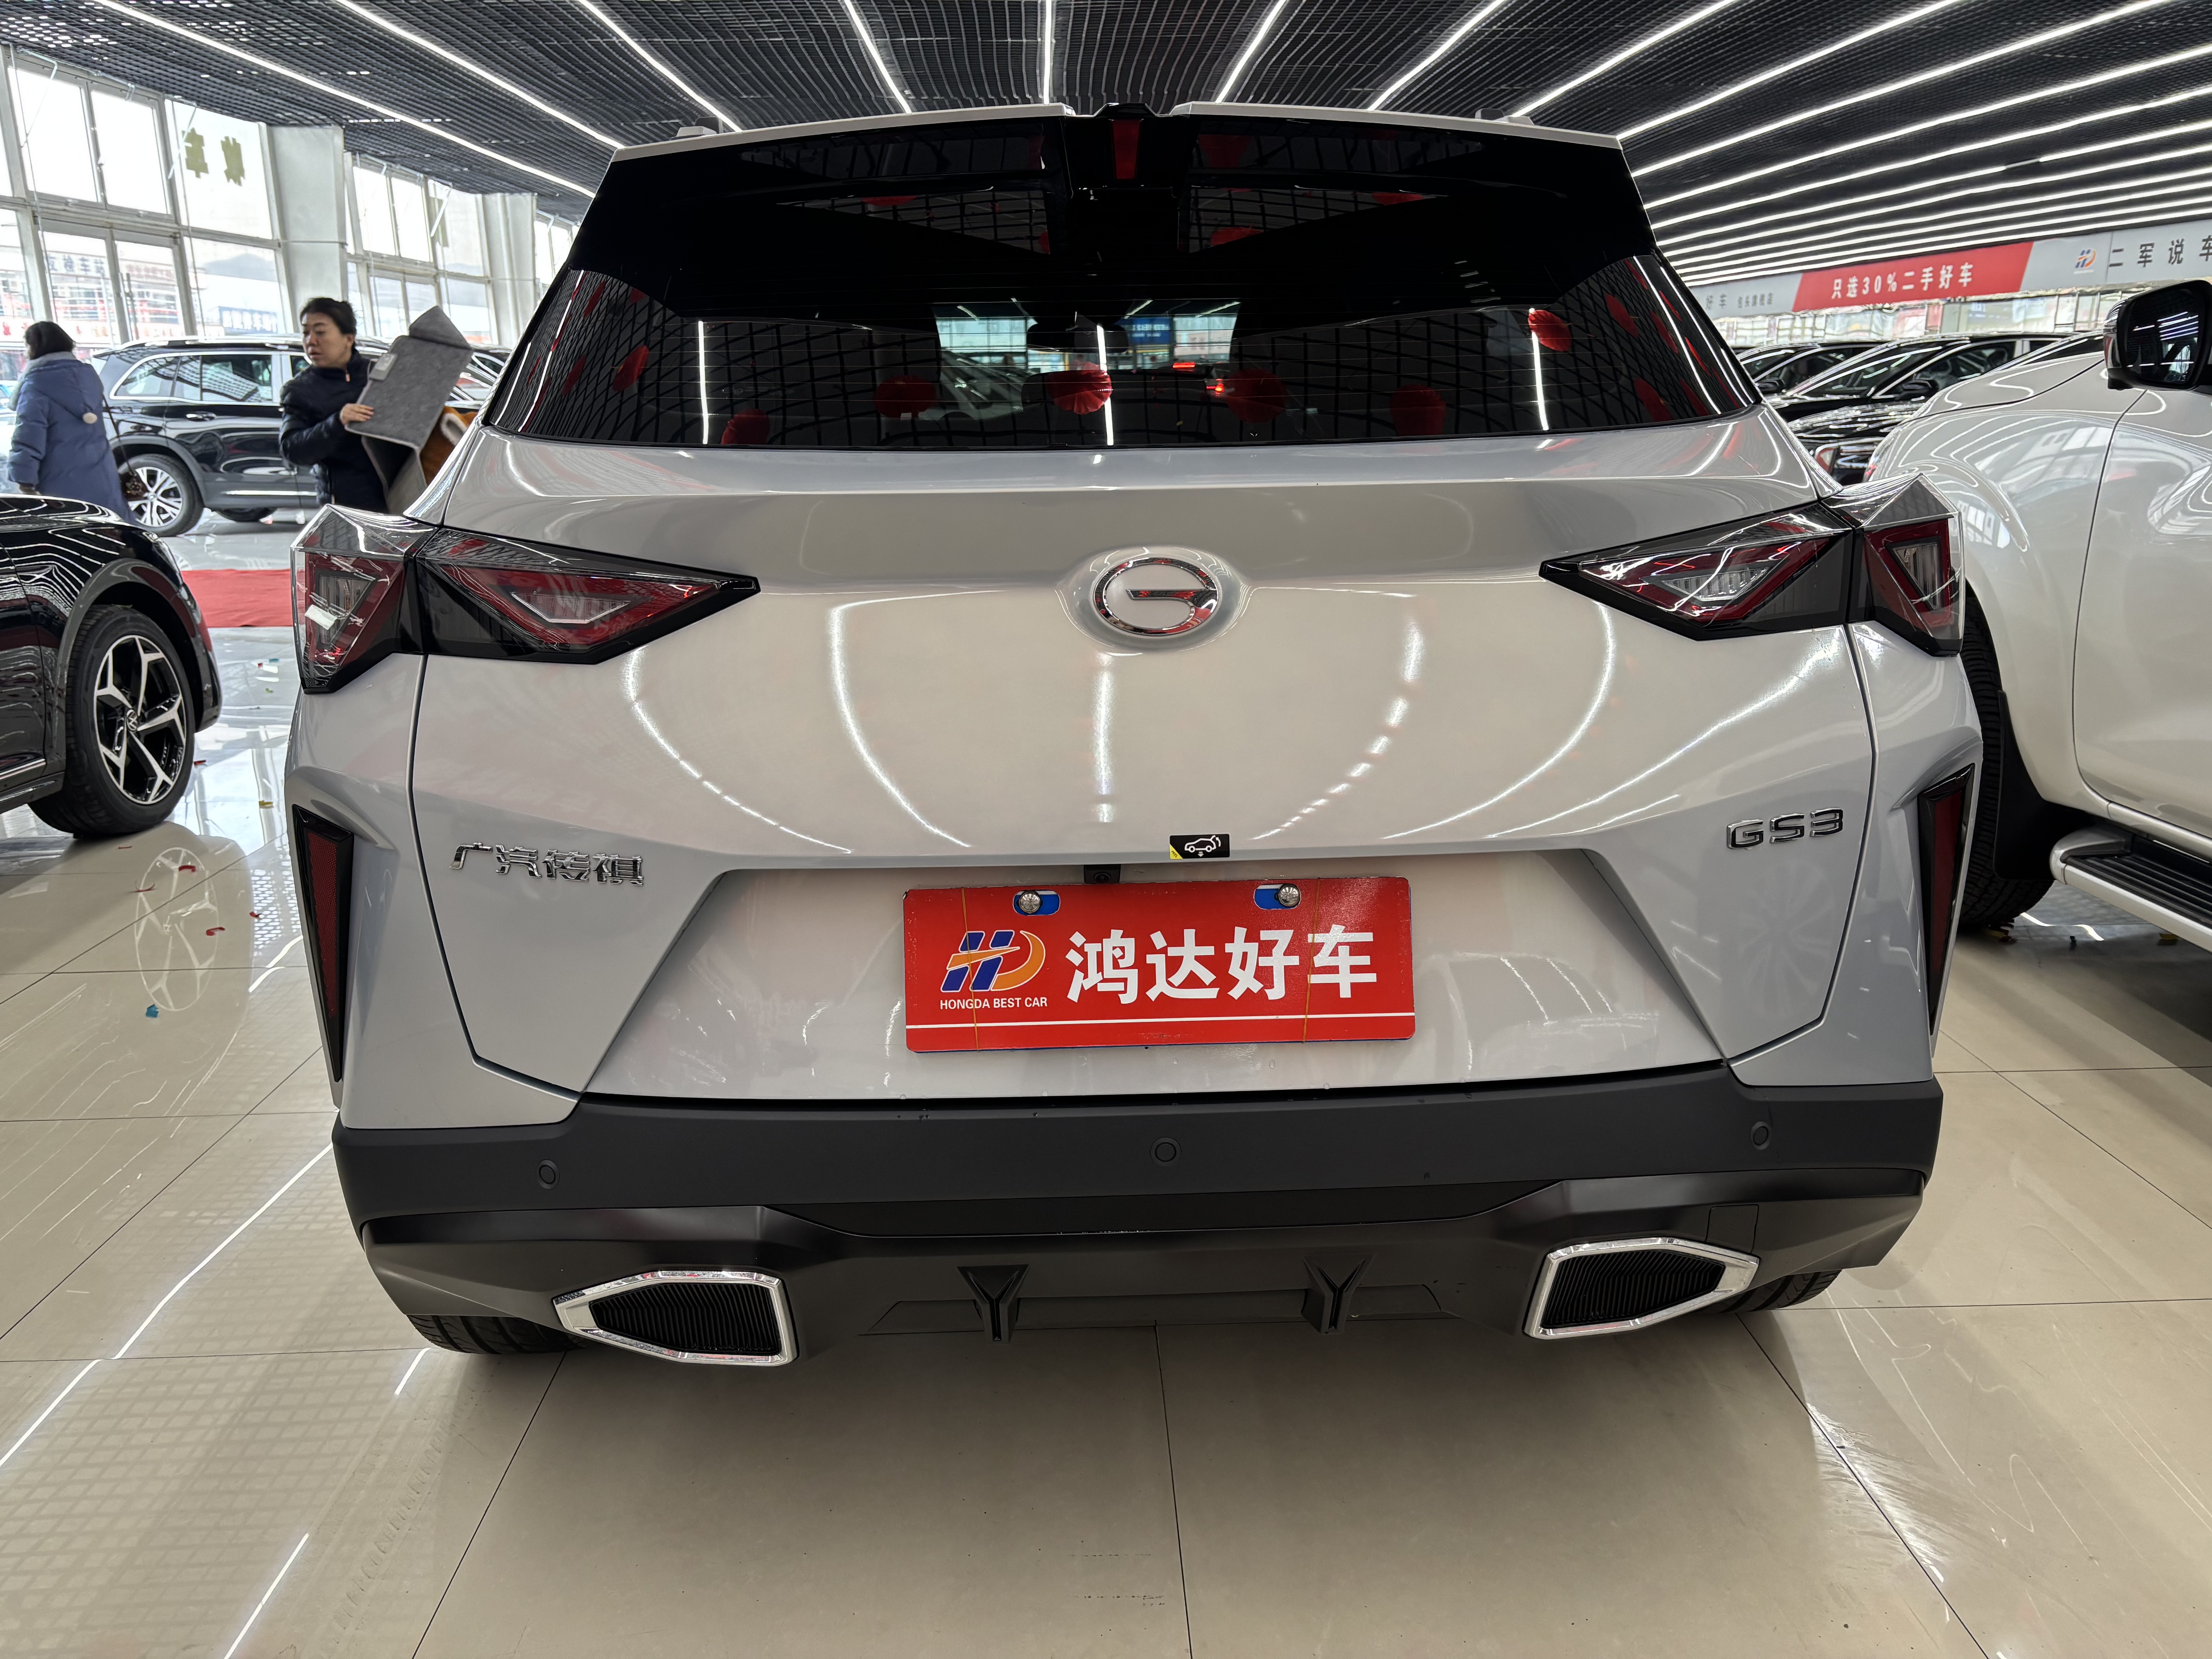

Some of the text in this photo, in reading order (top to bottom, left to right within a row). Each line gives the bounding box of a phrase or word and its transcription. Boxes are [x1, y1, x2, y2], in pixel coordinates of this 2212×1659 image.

[2109, 235, 2212, 268] 二军说车
[1831, 262, 1973, 300] 只选30%二手好车
[1727, 808, 1843, 849] GS3
[450, 842, 644, 886] 广汽传祺
[1066, 924, 1377, 1005] 鸿达好车
[940, 997, 1048, 1010] HONGDA BEST CAR
